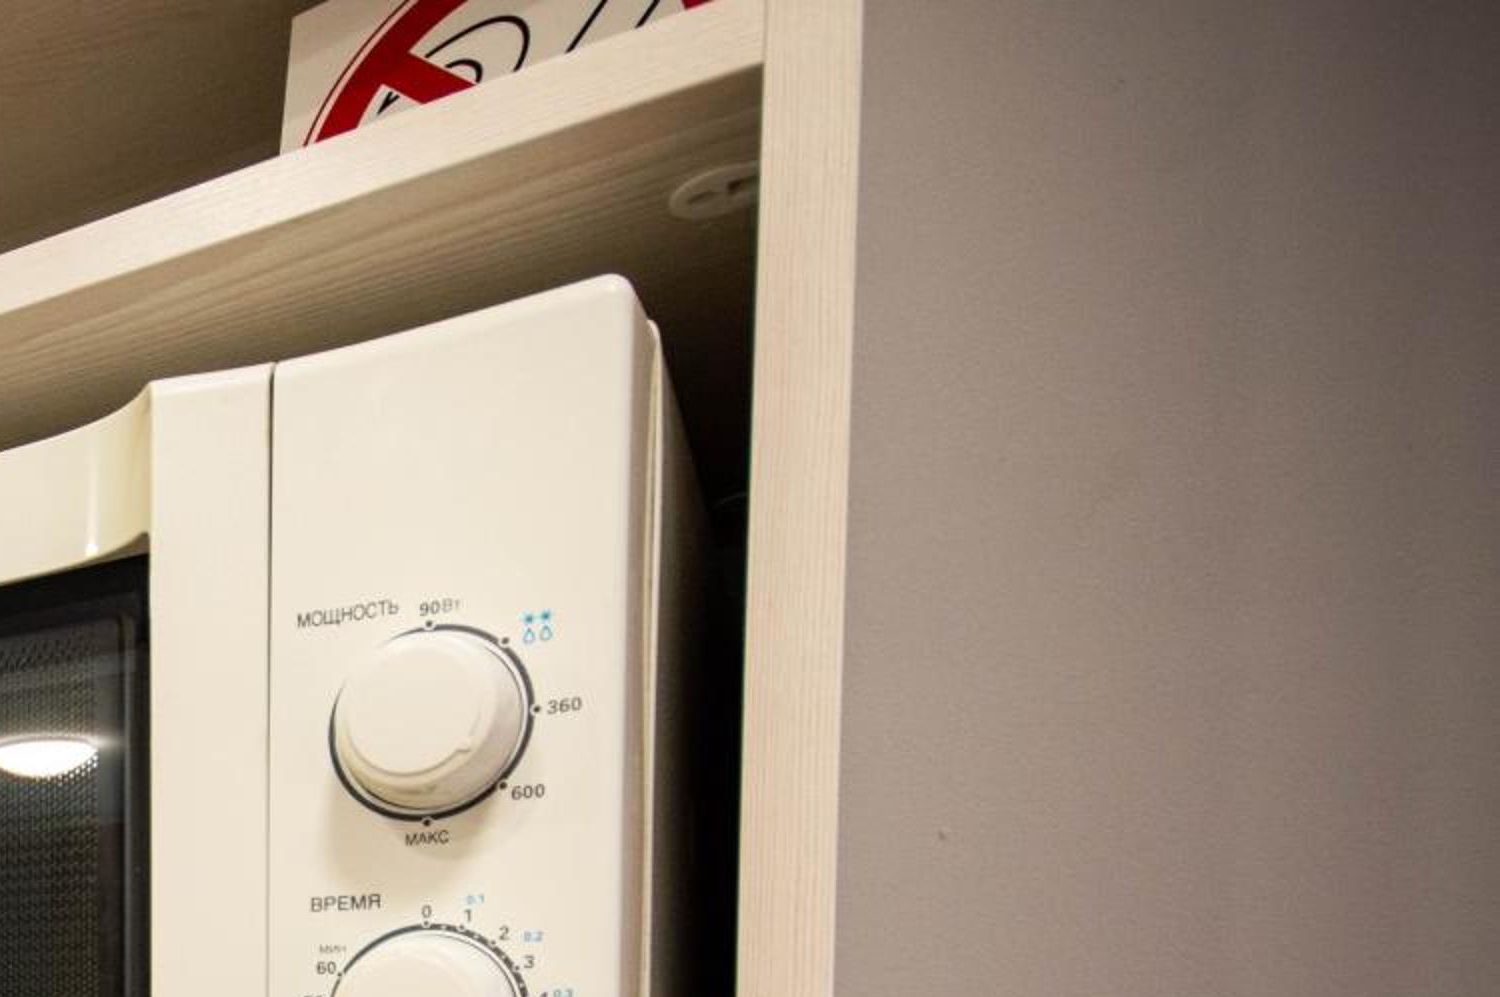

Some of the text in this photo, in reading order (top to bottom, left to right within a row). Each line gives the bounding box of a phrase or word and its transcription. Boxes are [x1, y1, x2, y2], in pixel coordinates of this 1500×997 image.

[297, 600, 399, 628] МОЩНОСТЬ
[547, 697, 582, 714] 360
[511, 783, 545, 800] 600
[405, 829, 449, 846] МАКС
[310, 894, 381, 912] ВРЕМЯ
[422, 906, 432, 918] 0
[464, 909, 472, 922] 1
[499, 926, 509, 940] 2
[316, 961, 337, 975] 60
[524, 955, 535, 969] 3
